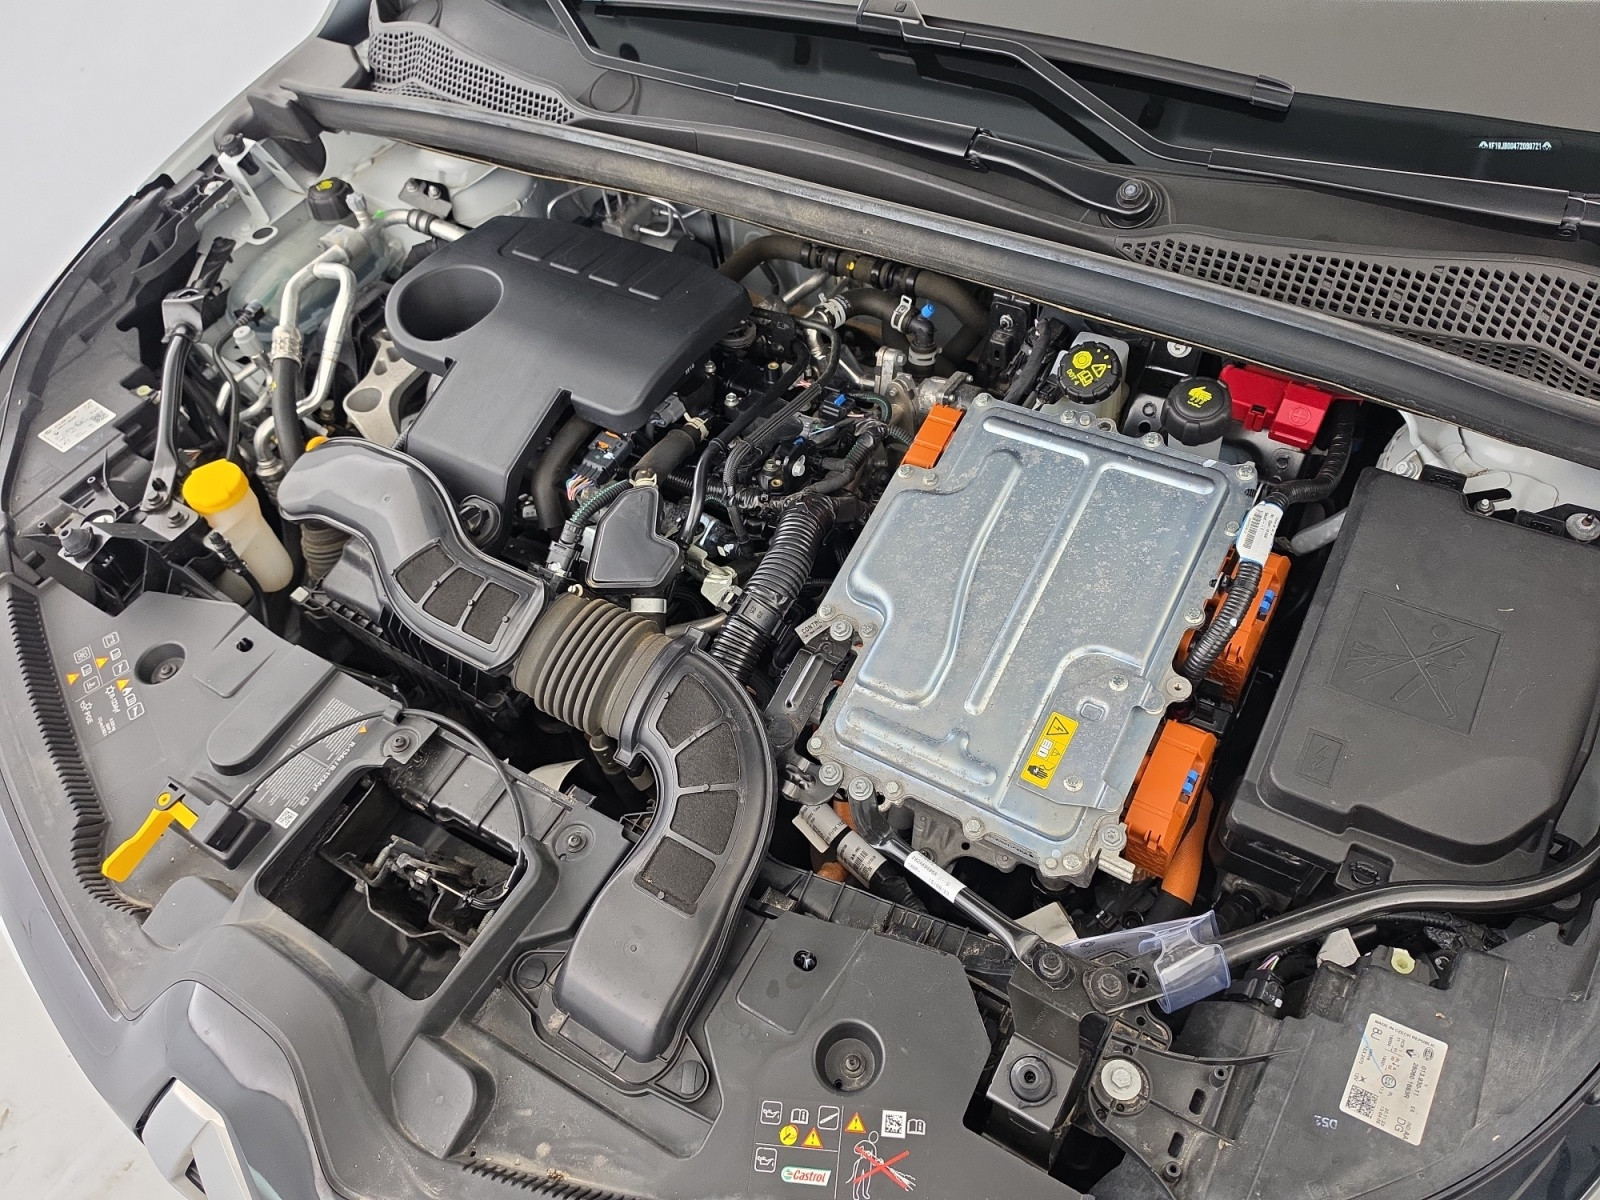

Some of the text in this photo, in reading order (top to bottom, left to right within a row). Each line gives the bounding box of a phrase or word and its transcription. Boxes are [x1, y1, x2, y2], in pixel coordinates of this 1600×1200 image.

[1067, 368, 1077, 381] DOT
[84, 711, 94, 725] POE
[1374, 1019, 1388, 1027] MADE
[1395, 1028, 1411, 1038] CZECH
[1394, 1117, 1407, 1133] DG
[792, 1169, 827, 1183] Castrol
